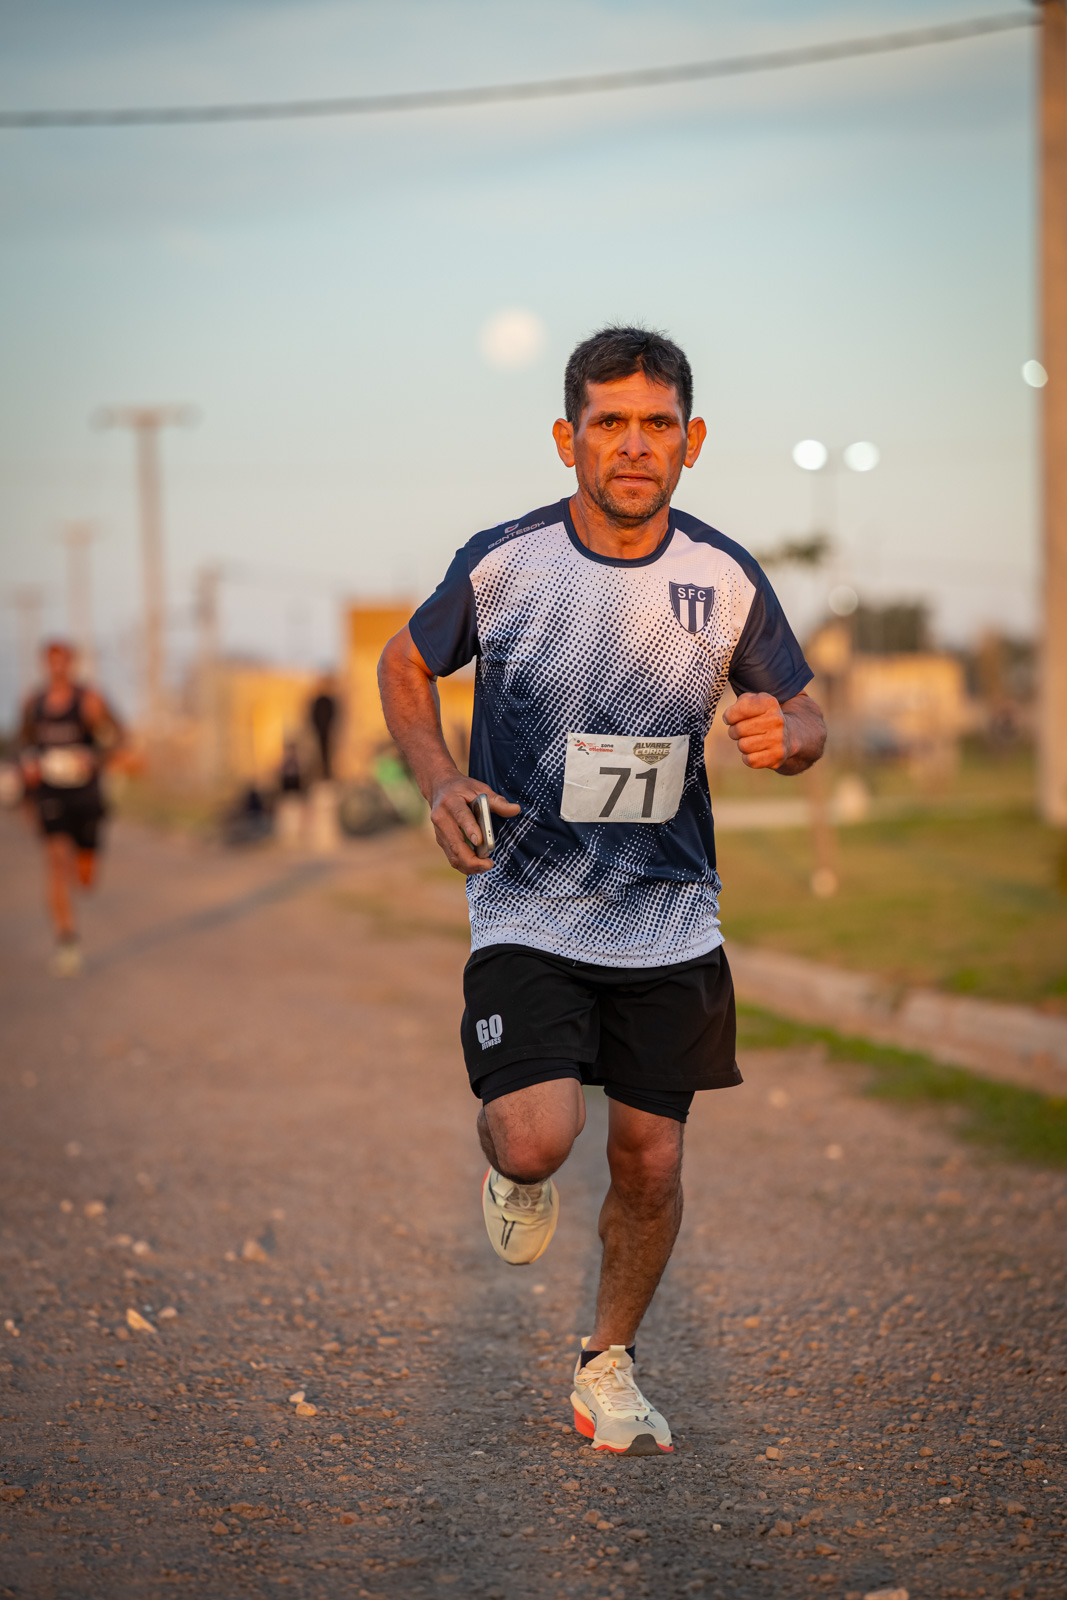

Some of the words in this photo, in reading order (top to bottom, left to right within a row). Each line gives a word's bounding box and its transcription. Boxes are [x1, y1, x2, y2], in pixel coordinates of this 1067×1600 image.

[677, 587, 706, 601] SFC
[633, 742, 672, 751] ALVAREZ
[635, 748, 670, 756] CORRE
[598, 766, 658, 818] 71
[475, 1014, 503, 1044] GO
